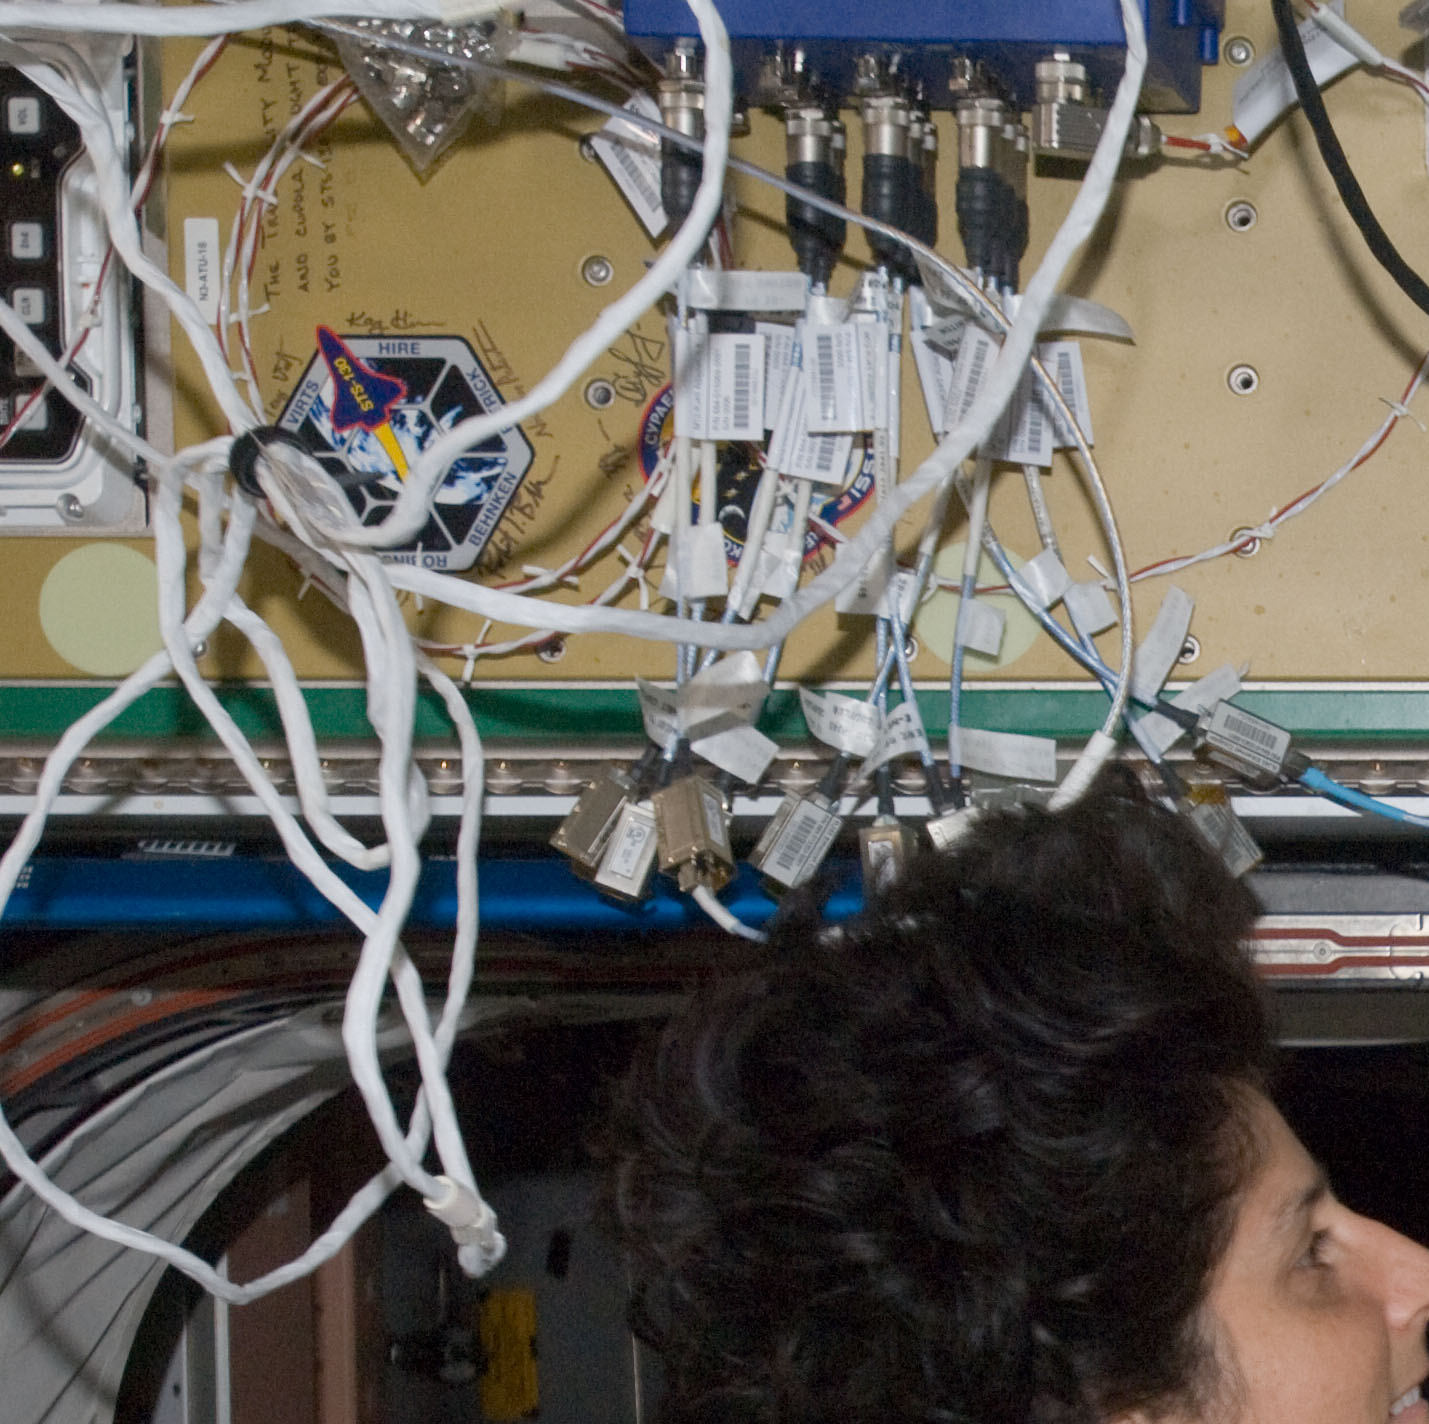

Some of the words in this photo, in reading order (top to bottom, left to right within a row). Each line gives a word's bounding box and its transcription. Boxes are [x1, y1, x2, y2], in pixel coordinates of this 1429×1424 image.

[378, 341, 421, 355] HIRE
[286, 380, 320, 426] VIRTS
[333, 356, 375, 413] STS-130
[467, 471, 518, 547] BEHNKEN
